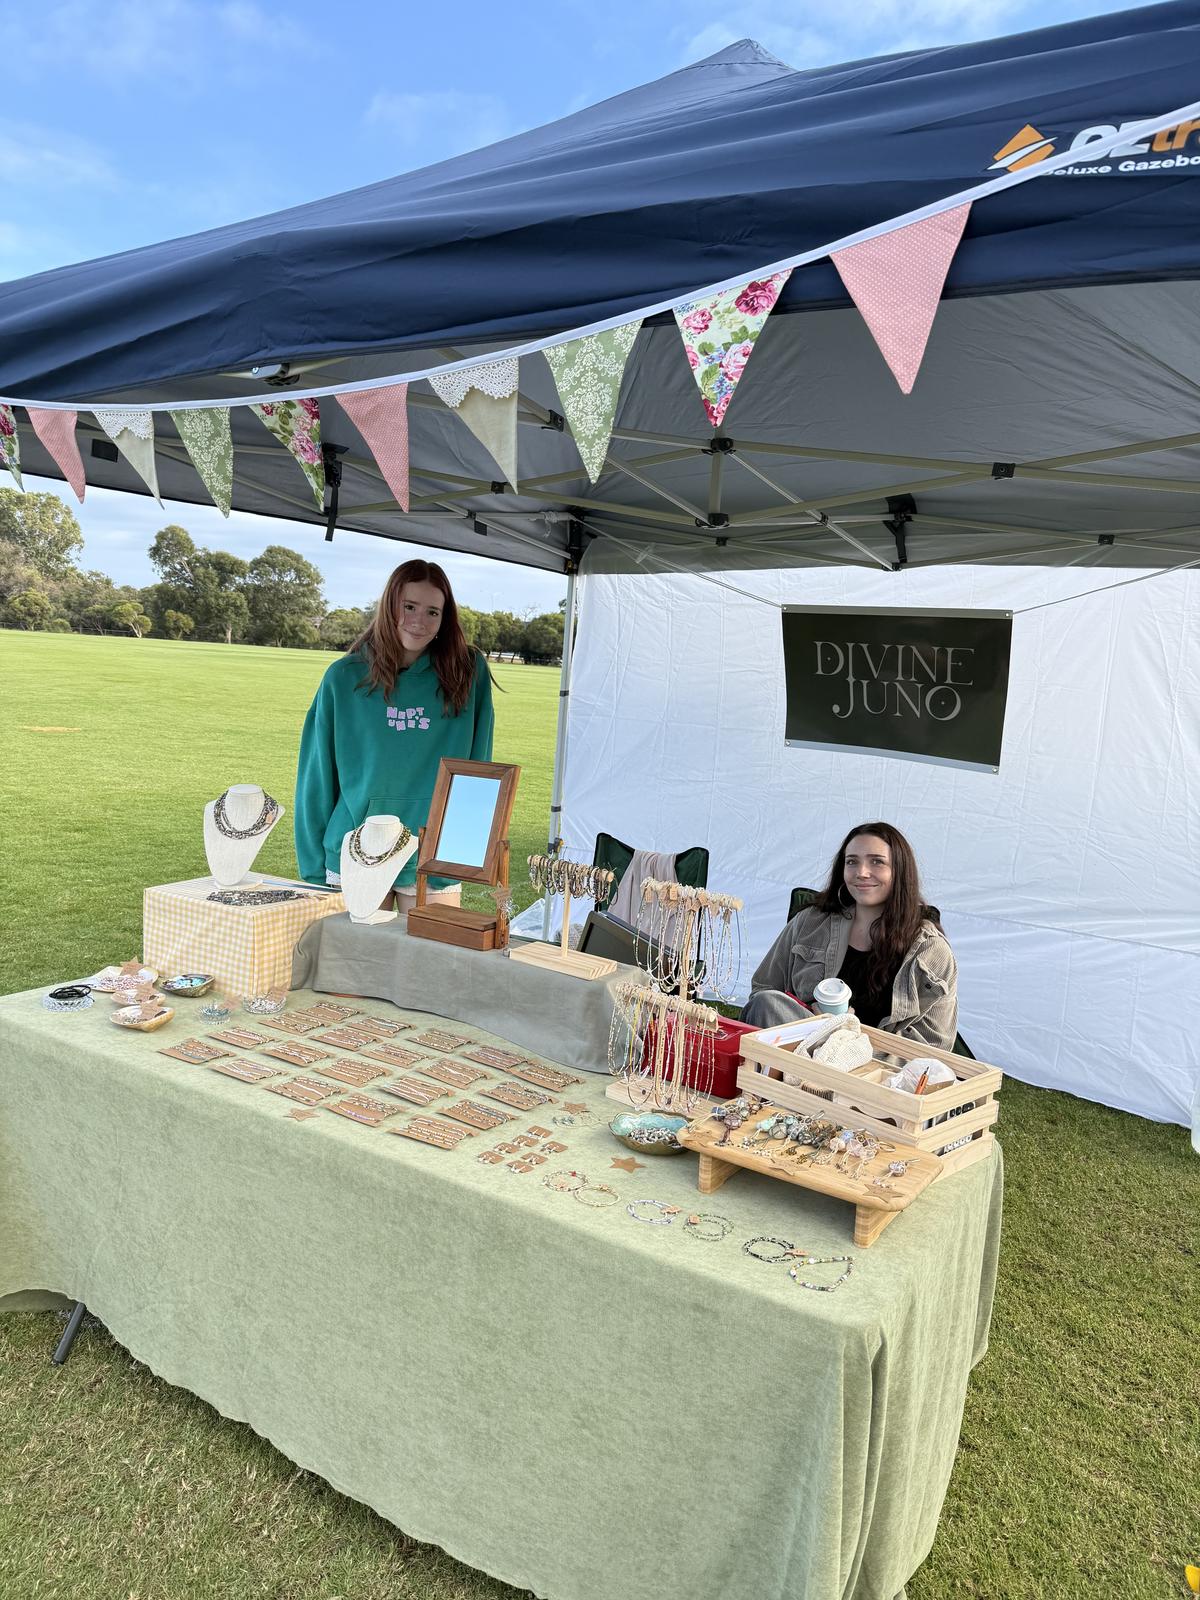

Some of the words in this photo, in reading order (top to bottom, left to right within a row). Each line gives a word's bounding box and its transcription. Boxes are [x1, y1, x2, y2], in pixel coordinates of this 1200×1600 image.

[1069, 116, 1200, 162] OZtr
[813, 641, 975, 685] DIVINE
[832, 677, 962, 721] JUNO
